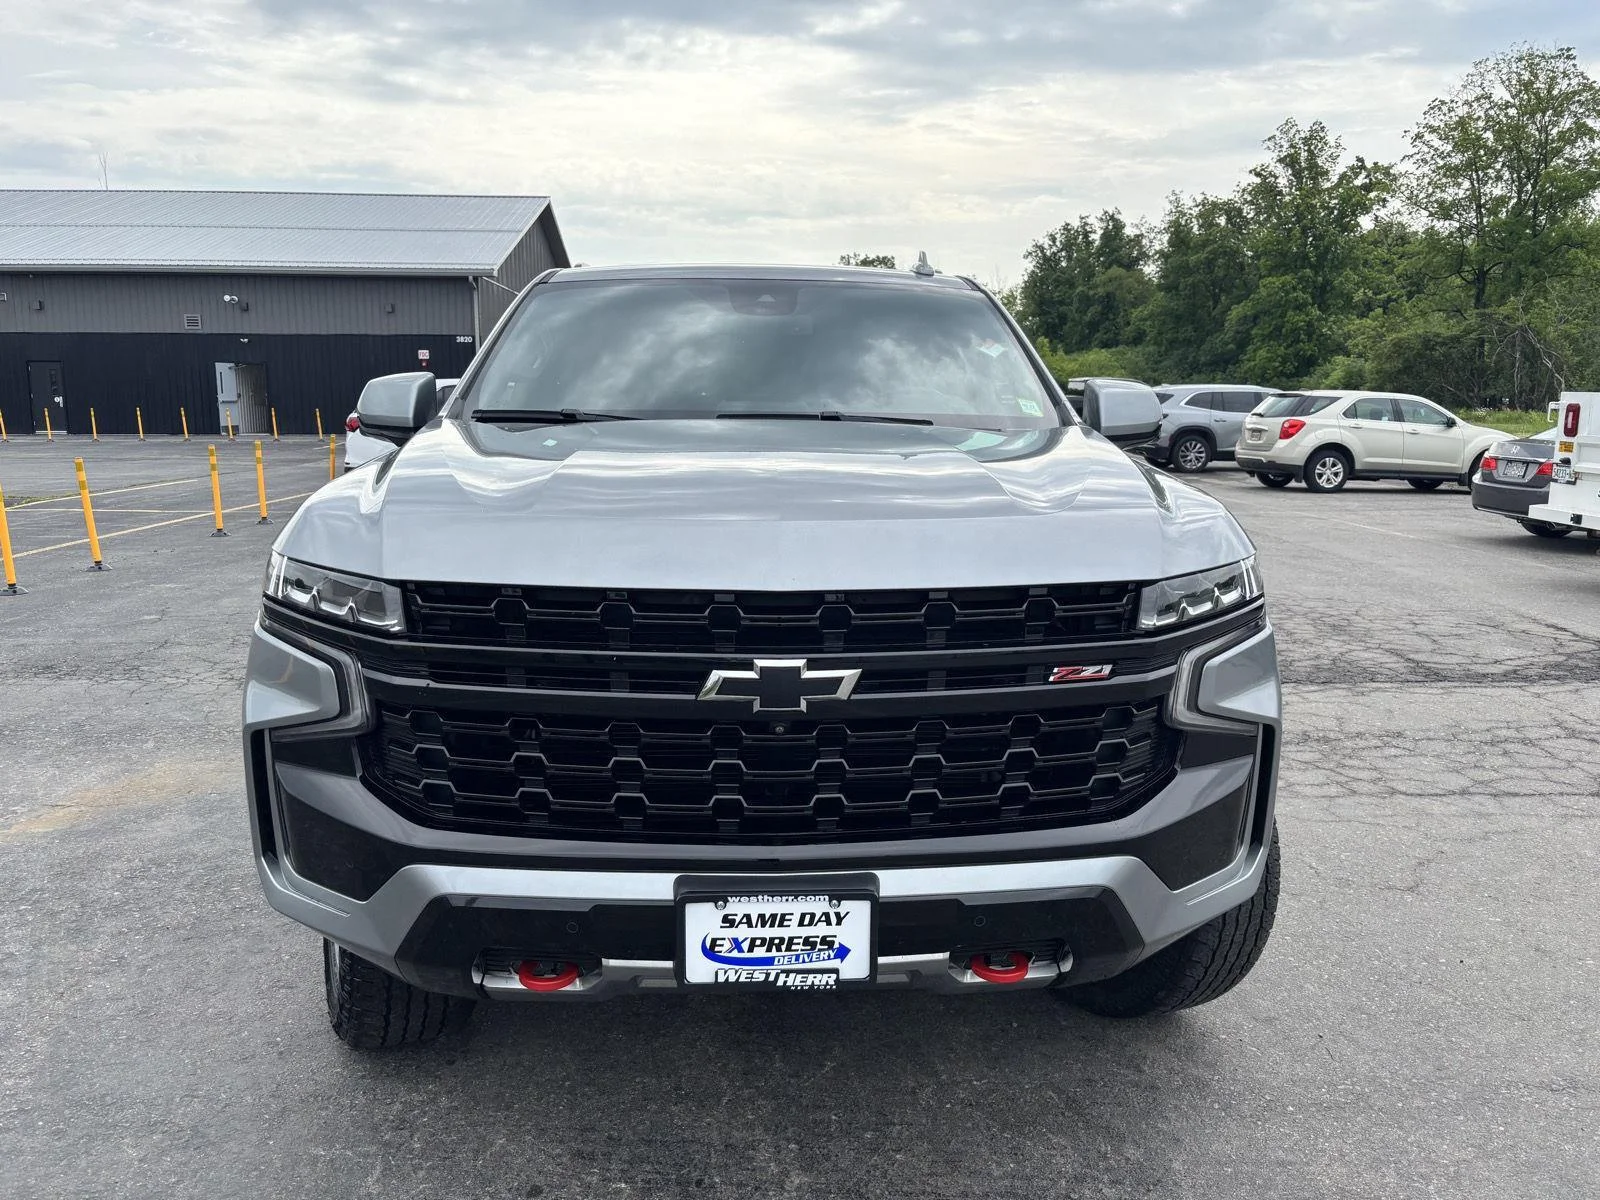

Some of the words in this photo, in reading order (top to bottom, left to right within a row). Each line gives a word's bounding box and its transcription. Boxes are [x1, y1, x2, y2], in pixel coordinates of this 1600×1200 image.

[727, 895, 829, 903] westherr.com
[720, 912, 794, 929] SAME
[797, 911, 850, 927] DAY
[709, 934, 837, 953] EXPRESS
[773, 949, 838, 966] DELIVERY
